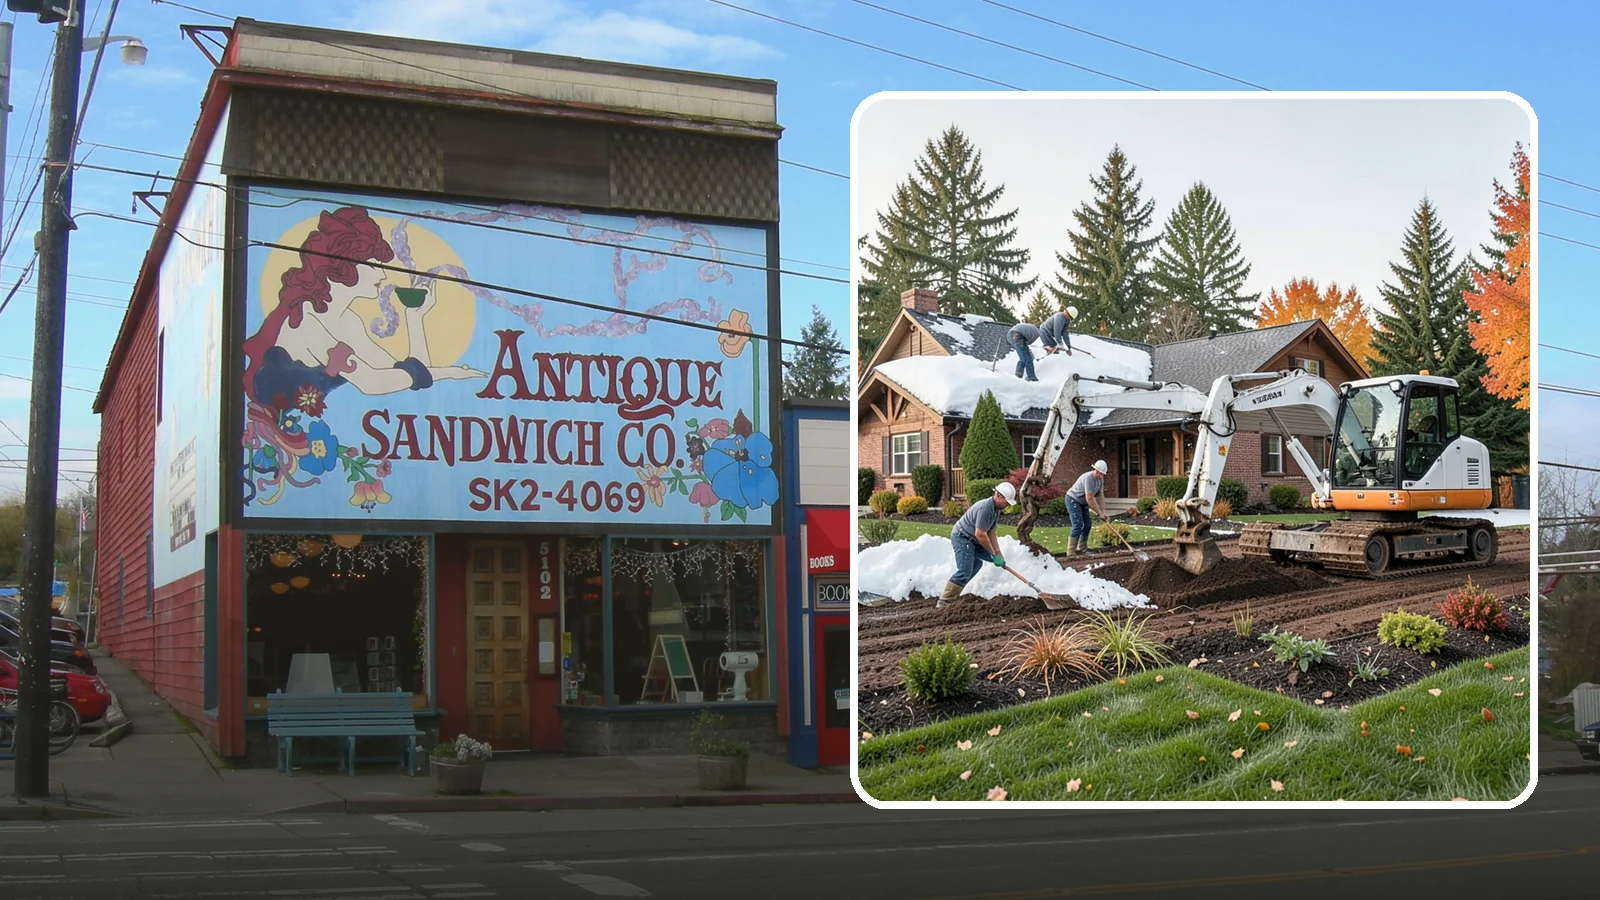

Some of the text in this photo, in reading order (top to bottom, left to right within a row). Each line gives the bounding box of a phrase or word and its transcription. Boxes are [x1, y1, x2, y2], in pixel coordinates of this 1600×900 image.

[475, 329, 724, 421] ANTIQUE
[360, 408, 685, 469] SANDWICH CO.
[468, 477, 646, 512] SK2-4069
[540, 542, 551, 599] 5102
[809, 555, 835, 569] BOOKS
